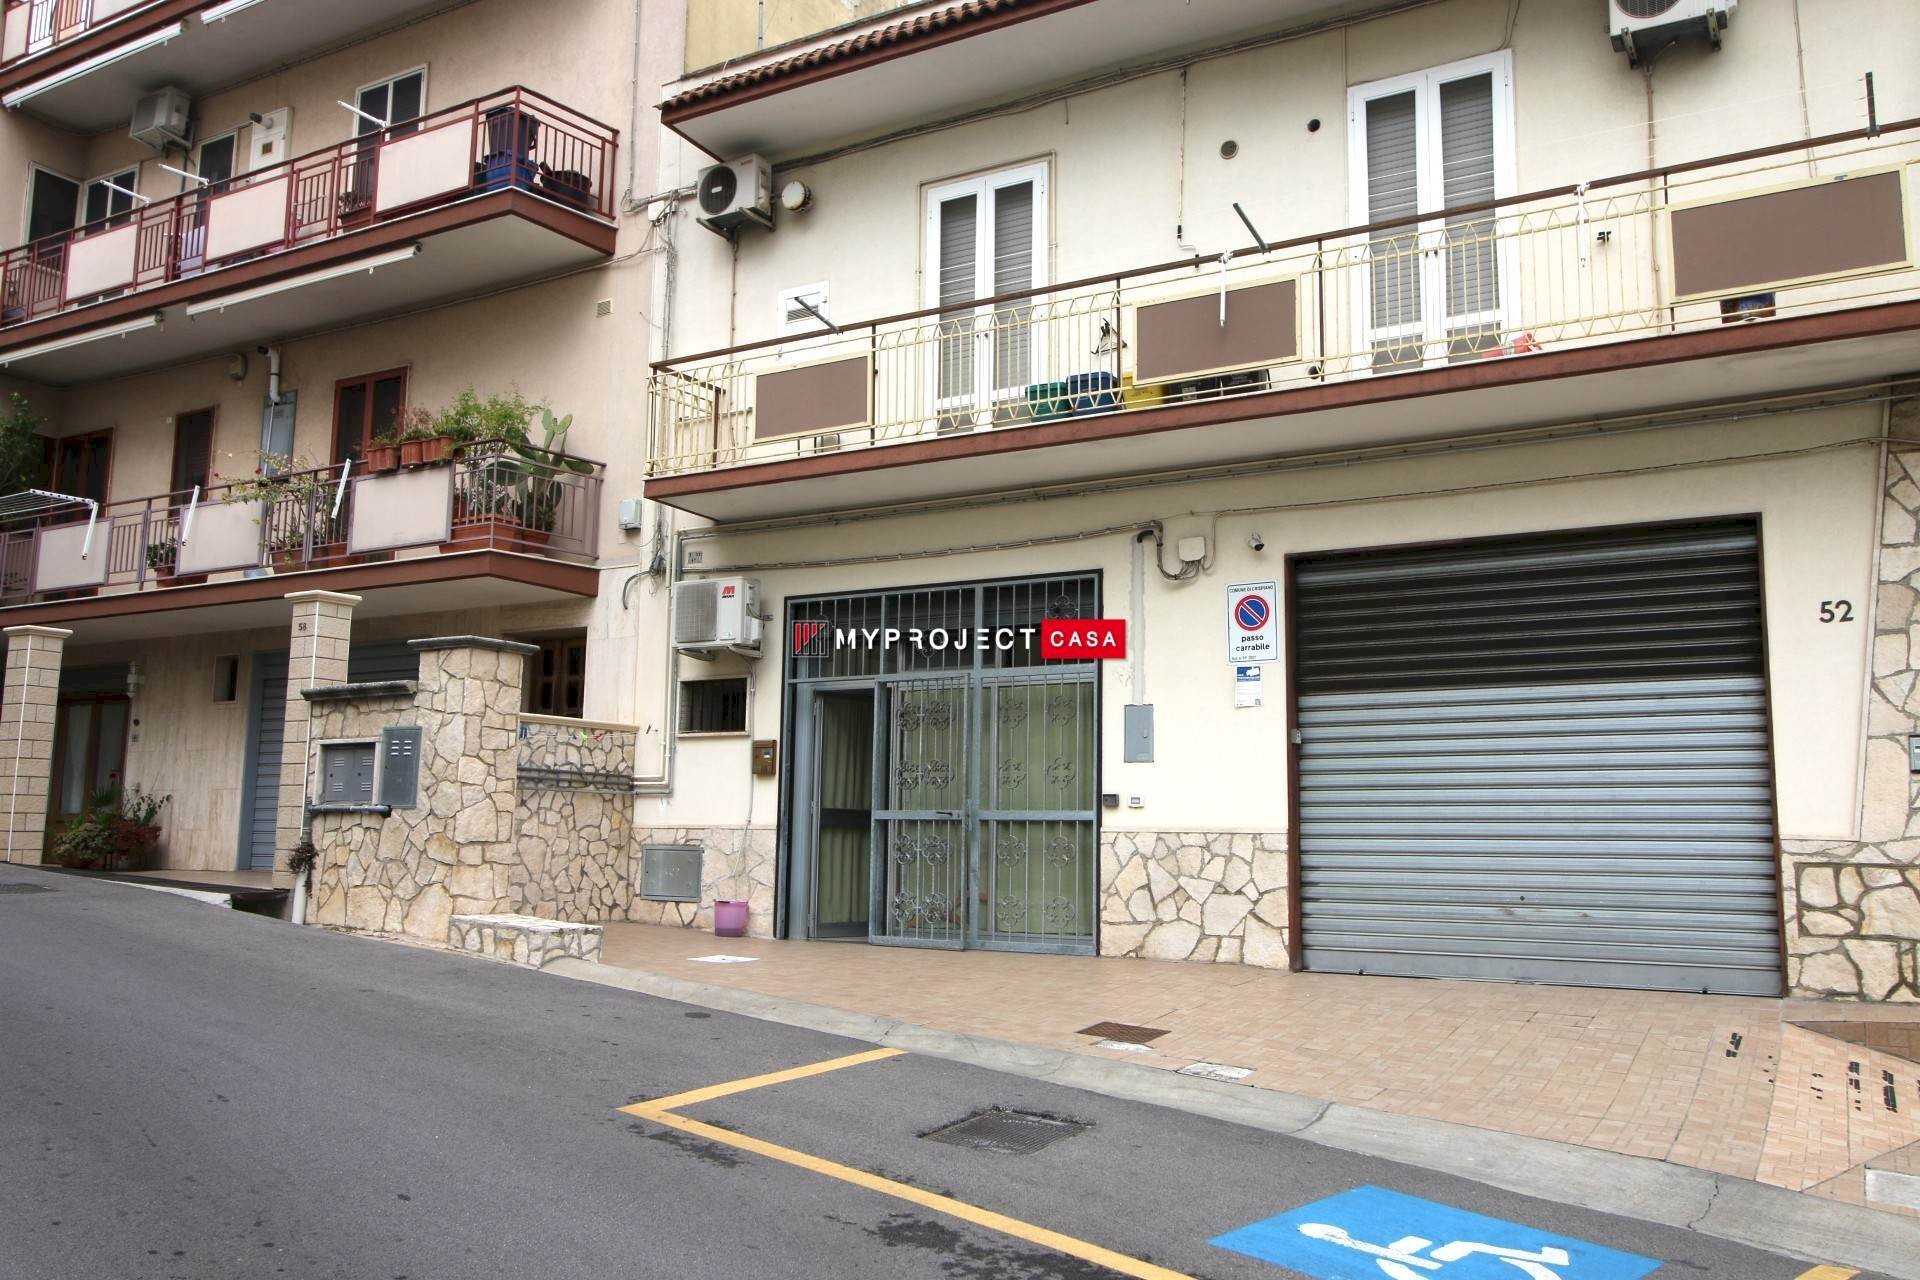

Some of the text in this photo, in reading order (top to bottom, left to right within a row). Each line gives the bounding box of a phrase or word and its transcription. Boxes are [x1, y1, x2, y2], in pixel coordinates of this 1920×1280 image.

[1819, 600, 1854, 623] 52
[836, 627, 1117, 650] MYPROJECT CASA
[1241, 635, 1264, 643] passo
[1236, 643, 1270, 652] carrabile
